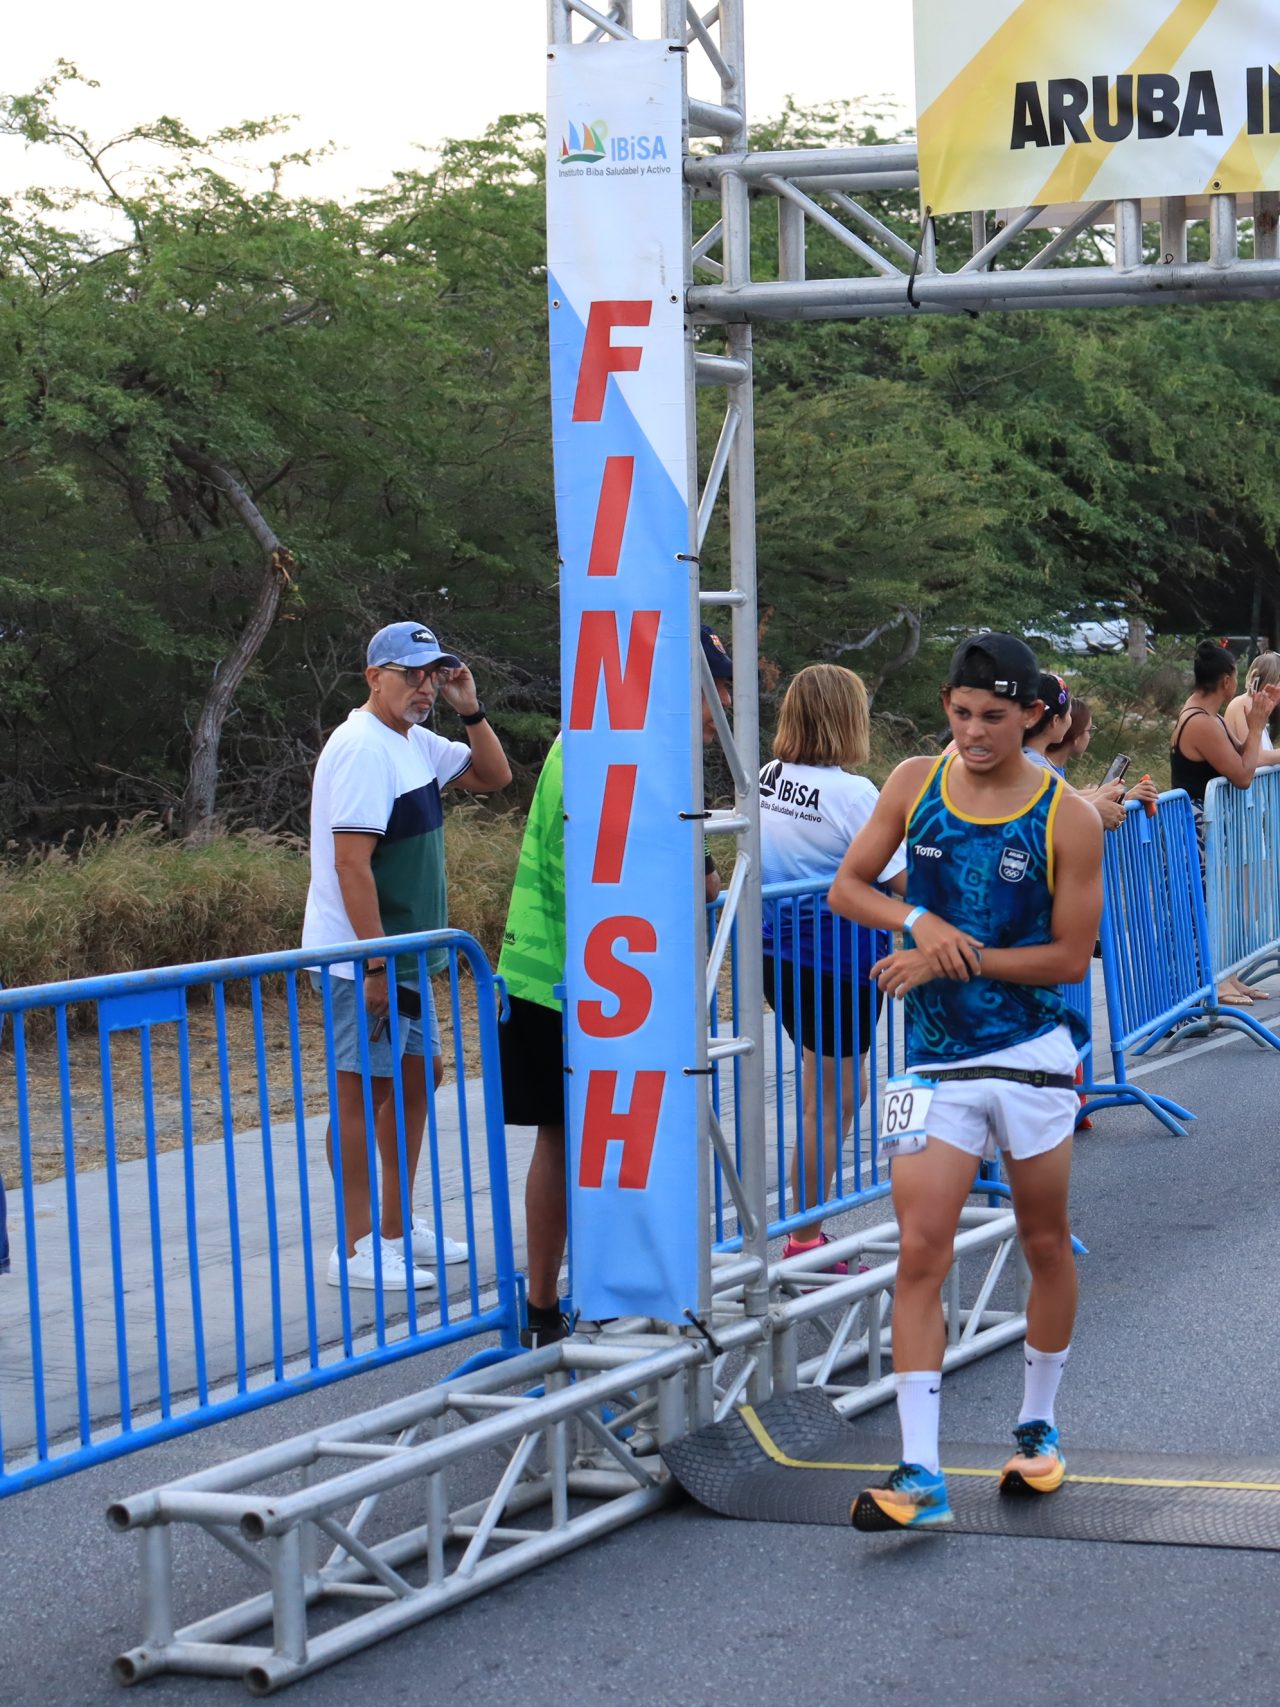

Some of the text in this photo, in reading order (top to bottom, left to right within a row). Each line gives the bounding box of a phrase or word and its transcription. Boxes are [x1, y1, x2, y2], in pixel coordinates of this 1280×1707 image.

[1010, 69, 1224, 150] ARUBA
[611, 135, 667, 161] IBiSA
[558, 164, 671, 178] Instituto Biba Saludabel y Activo
[569, 300, 666, 1189] FINISH
[778, 779, 820, 811] IBiSA
[799, 811, 822, 823] Activo
[914, 845, 943, 858] TOTTO
